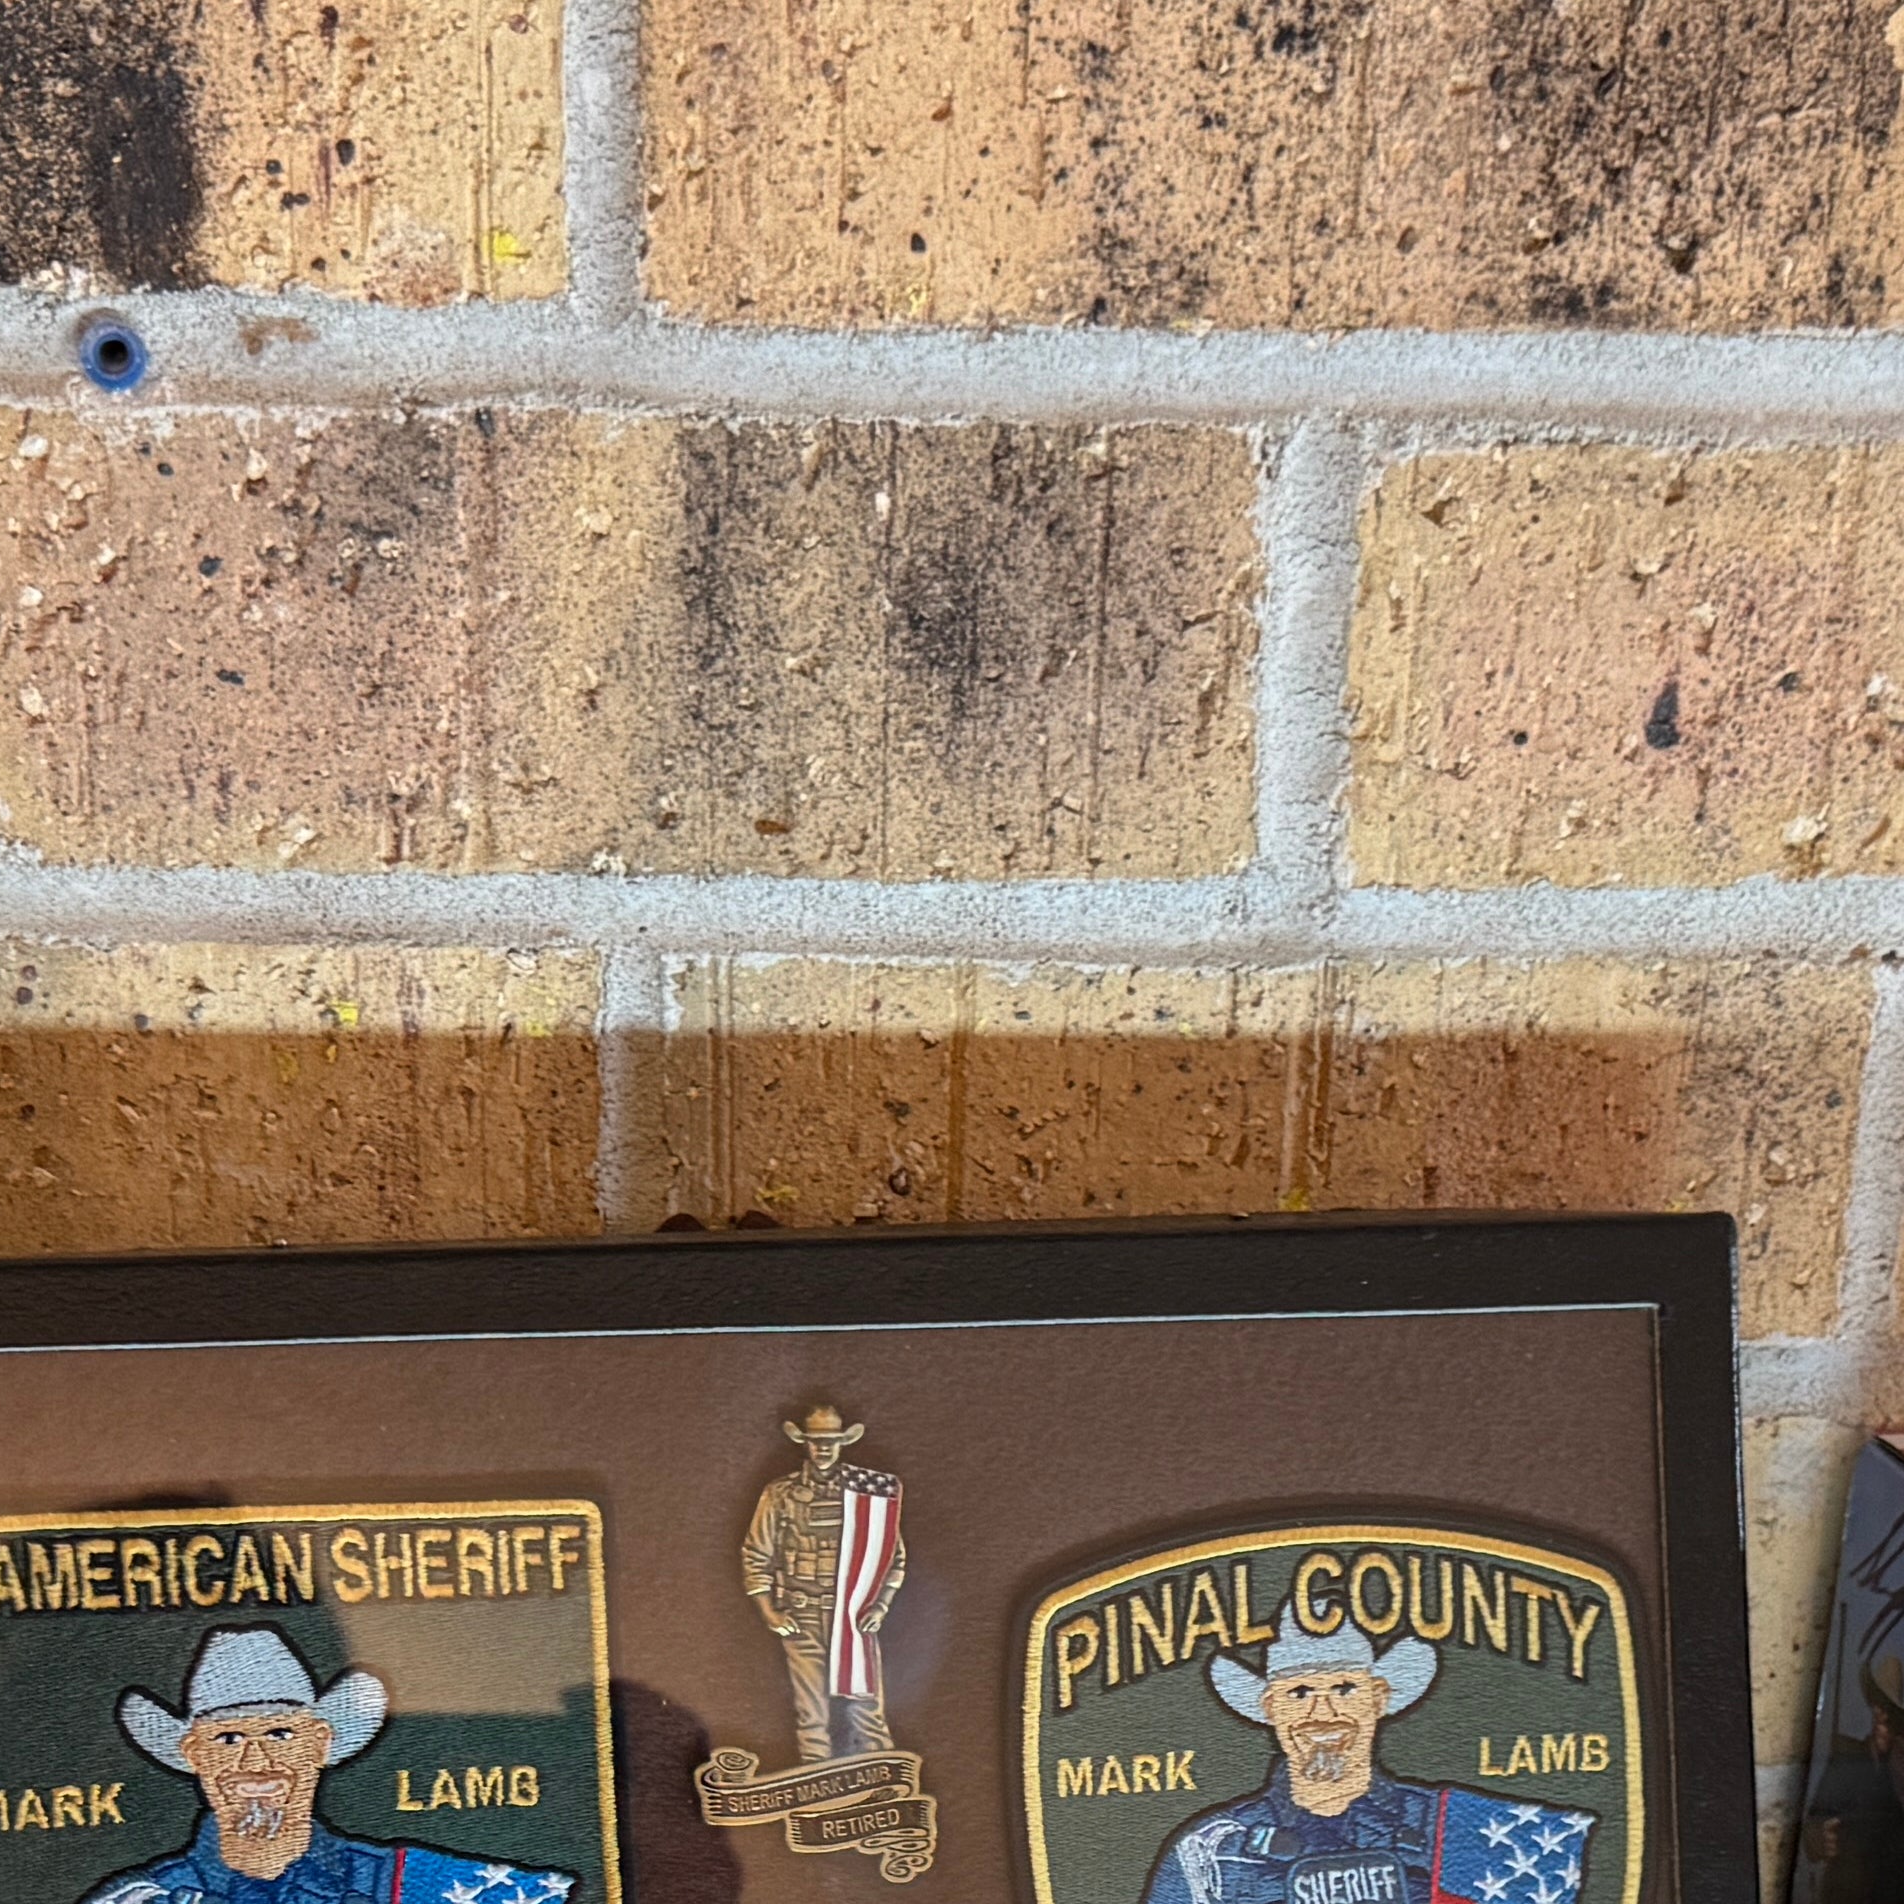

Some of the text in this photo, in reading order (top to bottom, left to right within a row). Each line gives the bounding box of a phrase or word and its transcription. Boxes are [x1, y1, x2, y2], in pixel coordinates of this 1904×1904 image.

[331, 1524, 585, 1602] SHERIFF
[1057, 1552, 1602, 1709] PINAL COUNTY
[396, 1765, 539, 1812] LAMB
[727, 1766, 891, 1813] SHERIFF MARK LAMB
[1056, 1733, 1610, 1798] MARK LAMB
[823, 1808, 900, 1839] RETIRED
